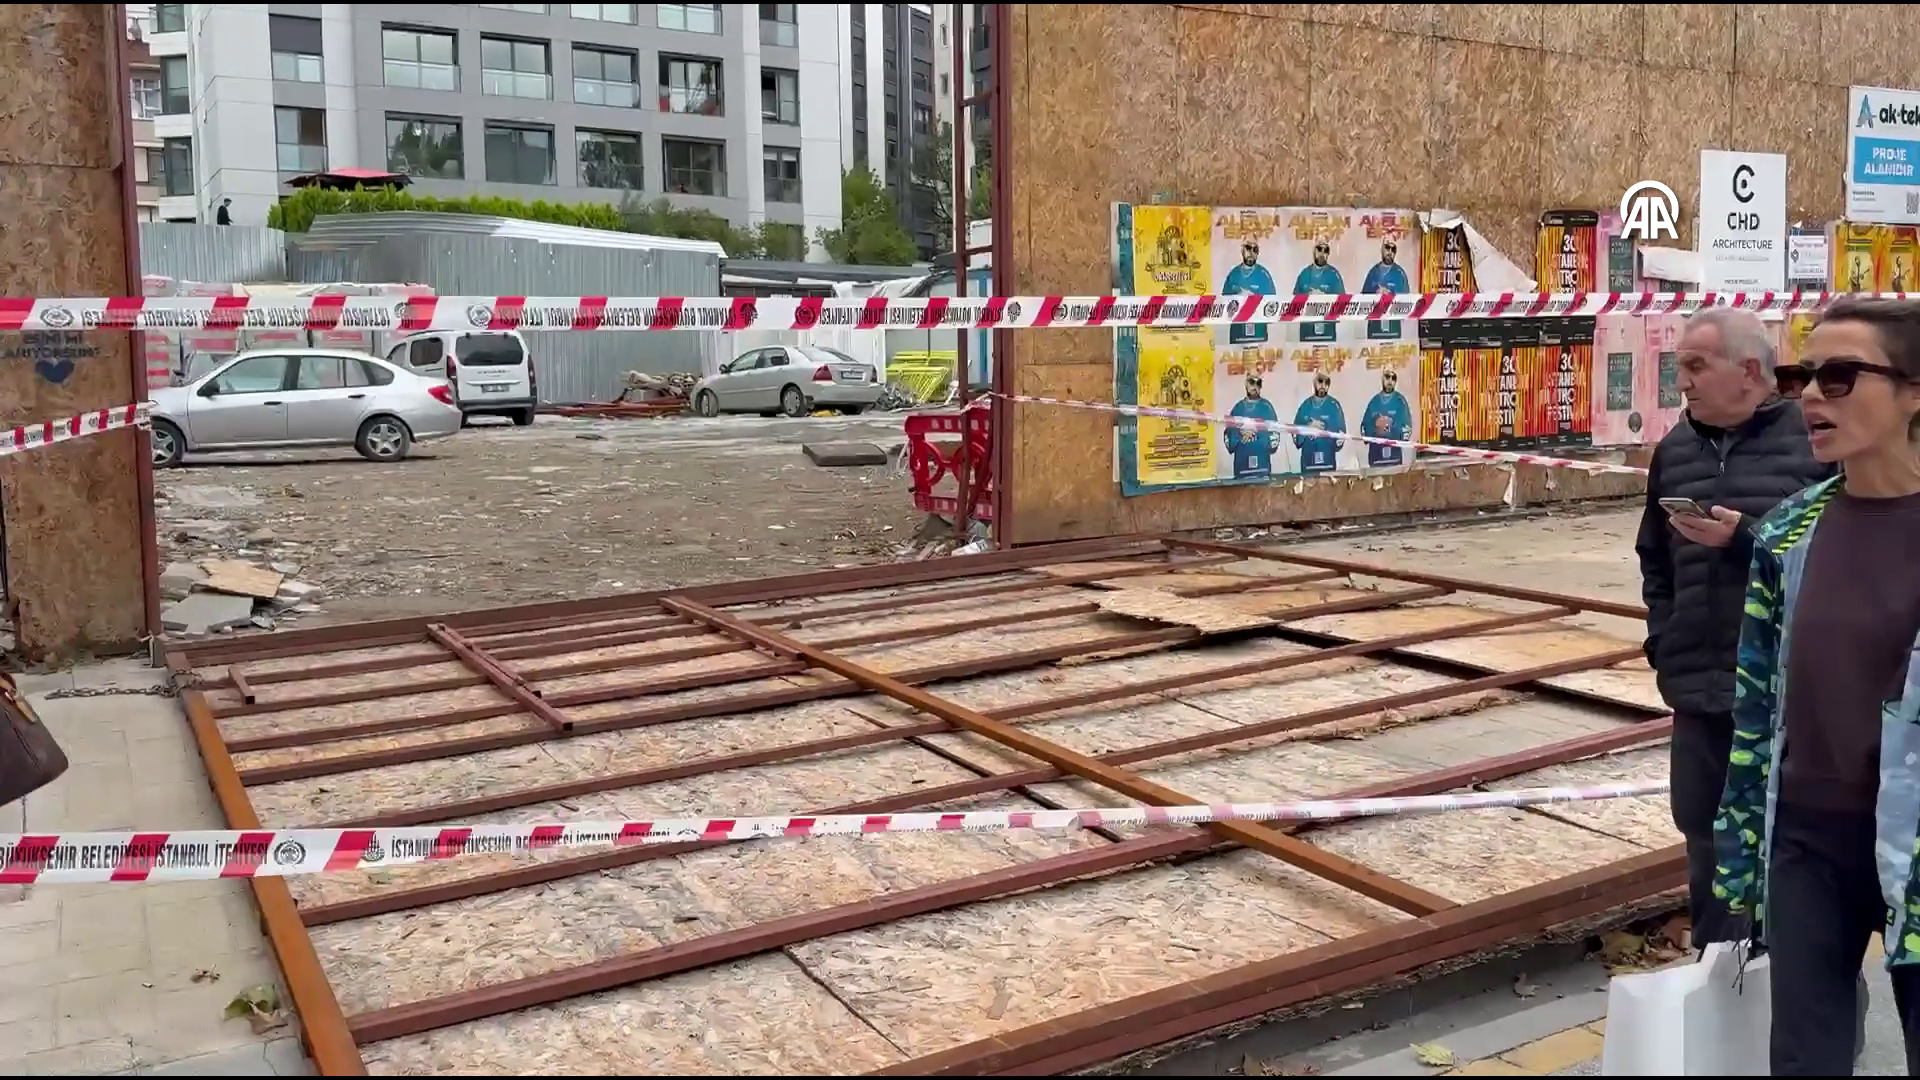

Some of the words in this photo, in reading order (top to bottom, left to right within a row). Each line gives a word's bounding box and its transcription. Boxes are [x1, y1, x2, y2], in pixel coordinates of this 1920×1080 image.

[1727, 212, 1760, 230] CHD
[1712, 239, 1773, 250] ARCHITECTURE
[81, 840, 152, 869] BELEDİYESİ
[154, 840, 210, 869] İSTANBUL
[214, 839, 269, 866] İTFAİYESİ
[391, 835, 441, 859] İSTANBUL
